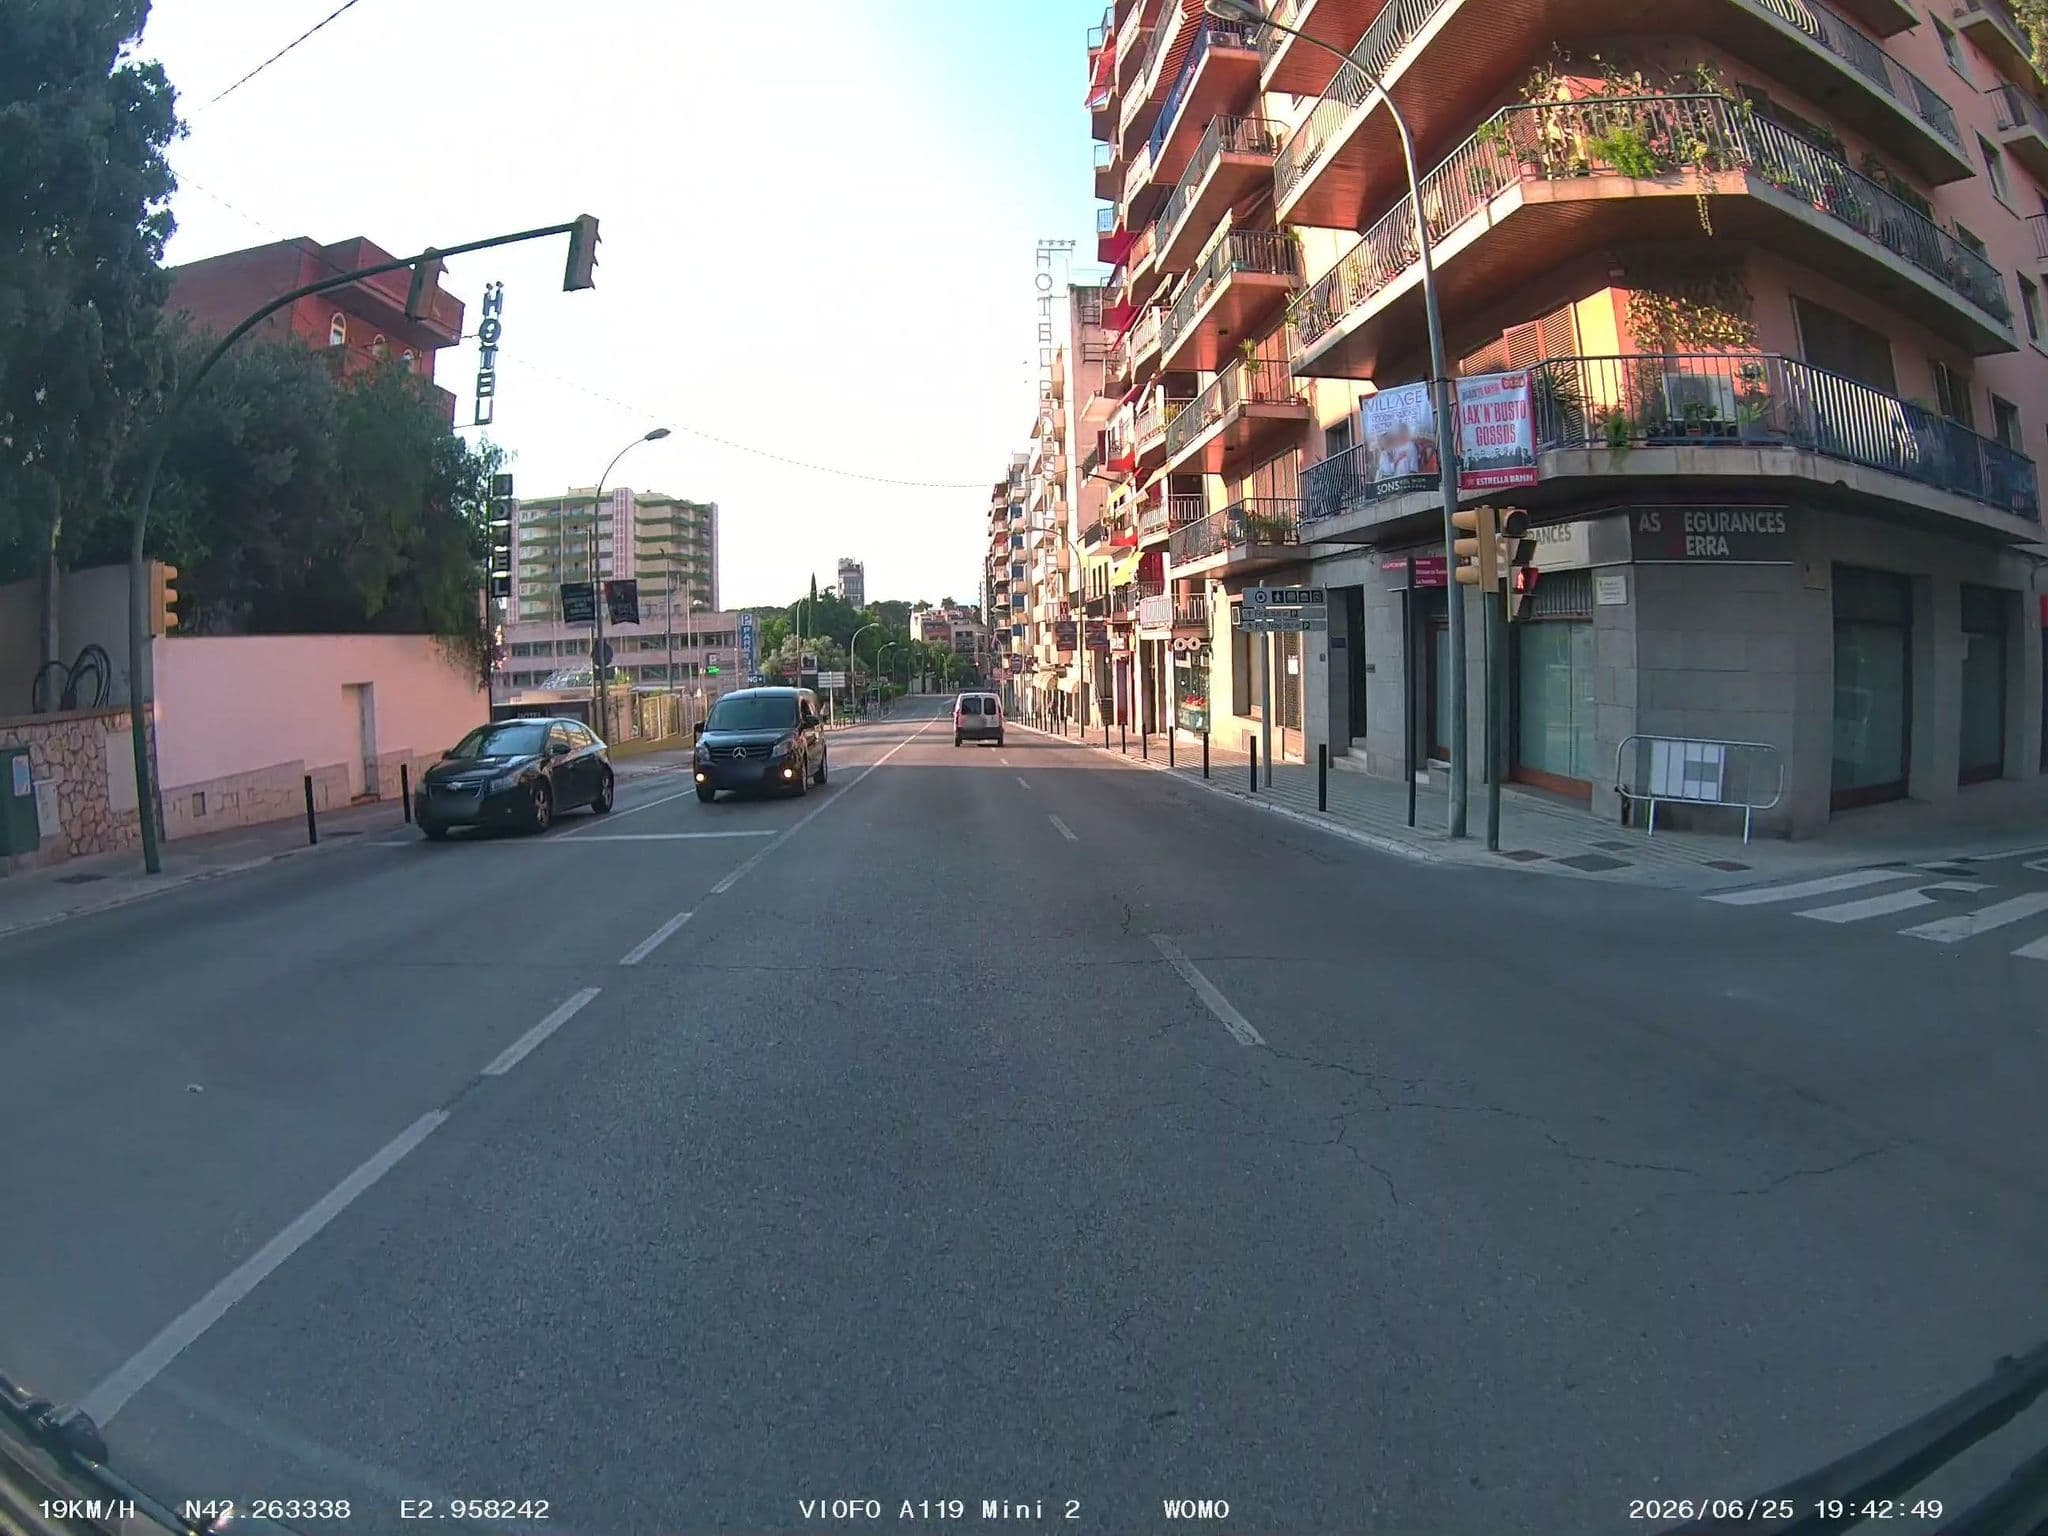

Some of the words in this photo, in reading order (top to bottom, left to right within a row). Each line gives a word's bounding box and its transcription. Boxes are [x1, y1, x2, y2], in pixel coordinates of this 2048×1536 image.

[1035, 249, 1053, 367] HOTEL
[475, 291, 504, 425] HOTEL
[1365, 390, 1423, 412] VILLAGE
[1476, 423, 1516, 446] GOSSOS
[1377, 480, 1400, 495] SONS
